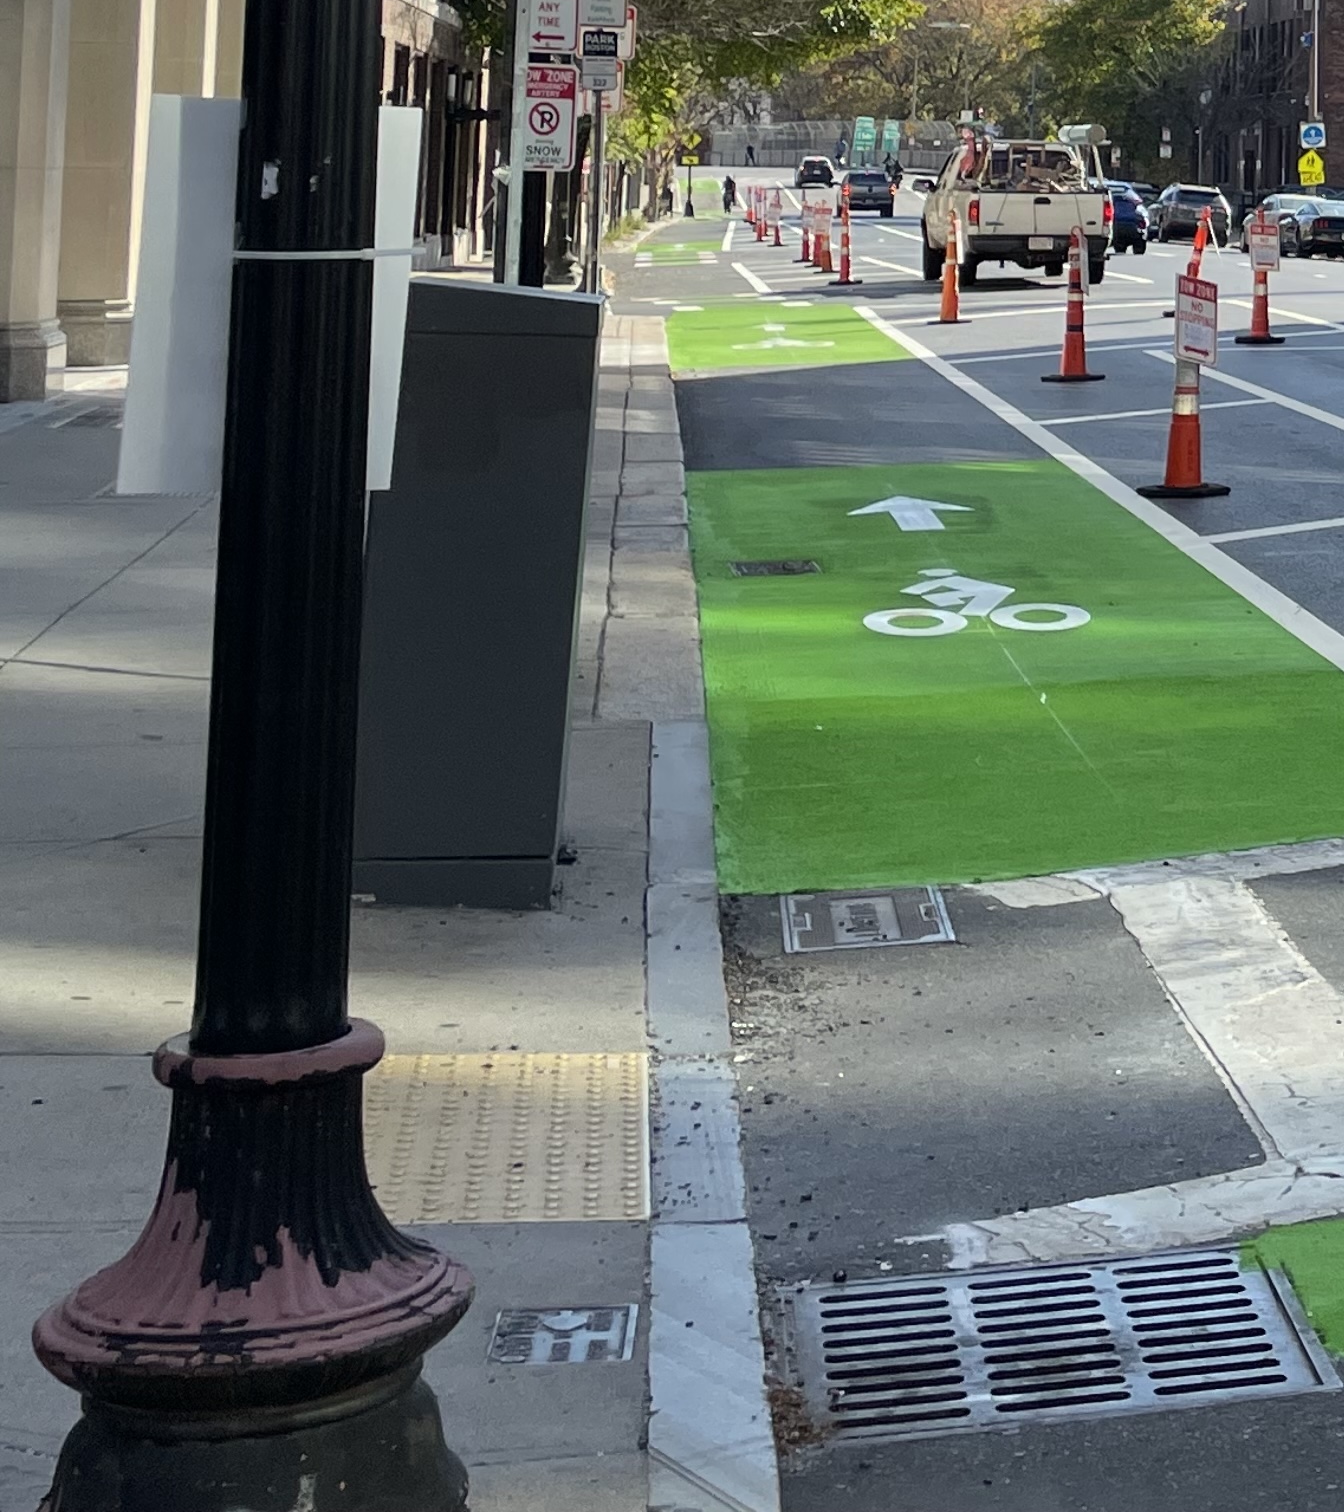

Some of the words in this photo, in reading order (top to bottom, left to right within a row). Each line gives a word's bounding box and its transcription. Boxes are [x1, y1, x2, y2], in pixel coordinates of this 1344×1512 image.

[538, 2, 560, 13] ANY
[538, 16, 560, 28] TIME
[584, 32, 615, 44] PARK
[527, 70, 542, 82] OW
[547, 71, 574, 84] ZONE
[526, 144, 561, 157] SNOW
[1191, 299, 1204, 314] NO
